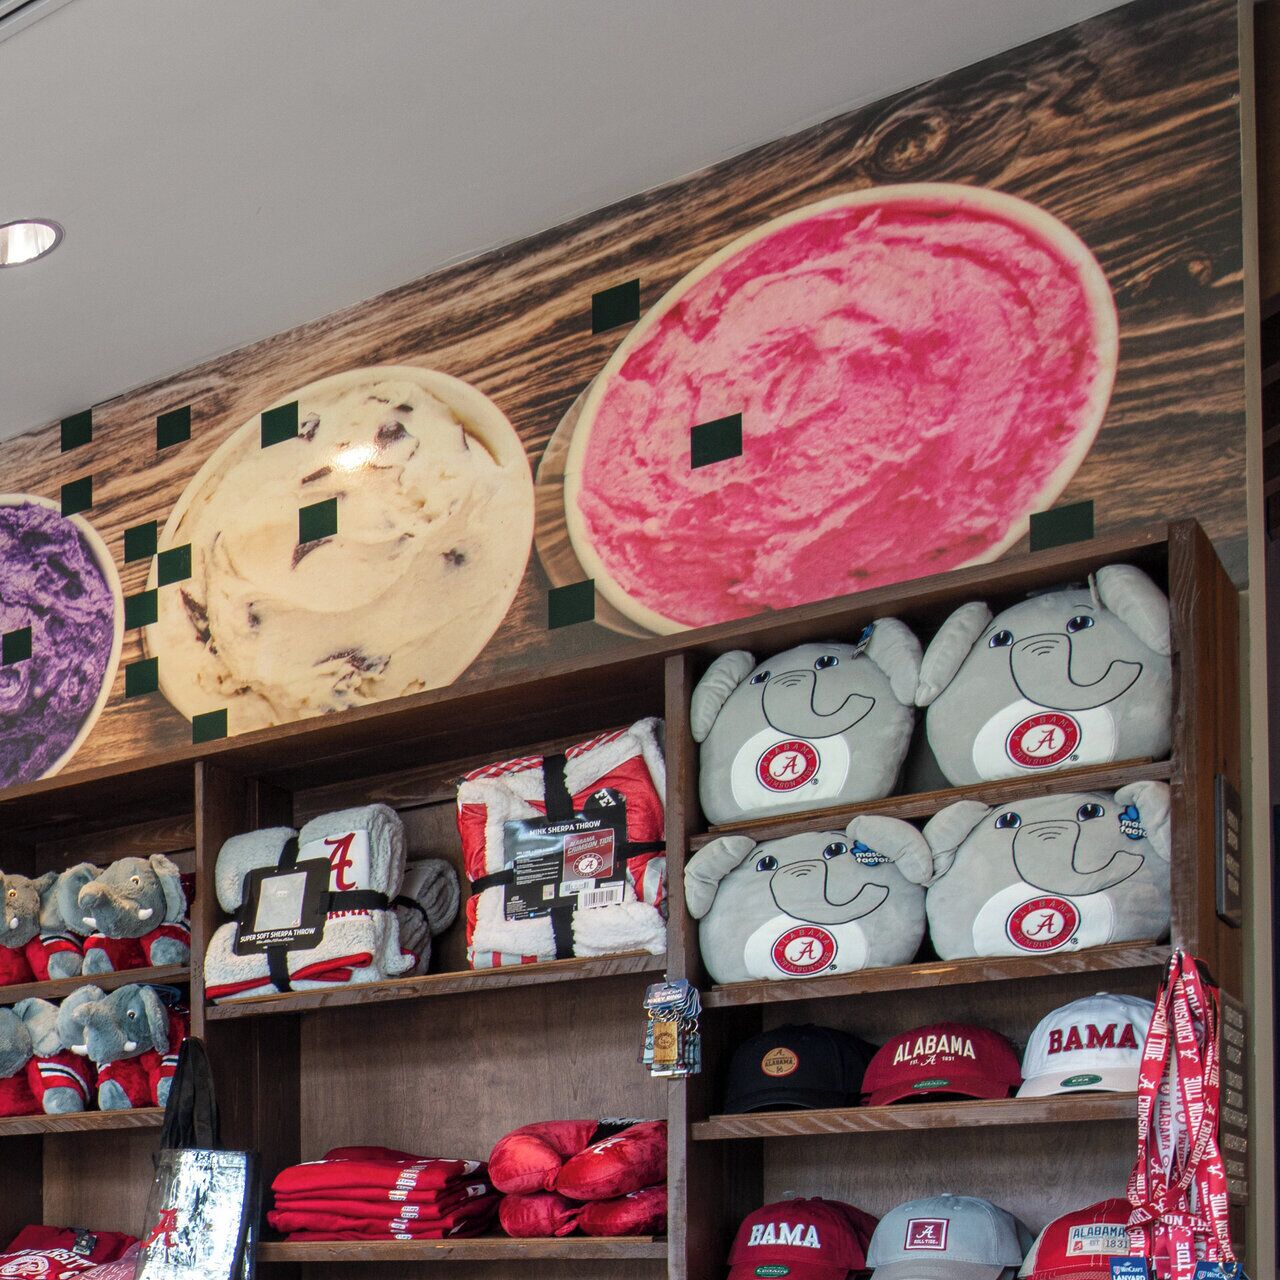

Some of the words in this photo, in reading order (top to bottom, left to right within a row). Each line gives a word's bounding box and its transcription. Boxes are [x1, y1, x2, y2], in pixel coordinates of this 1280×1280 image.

[1013, 715, 1074, 741] ALABAMA
[762, 743, 814, 767] ALABAMA
[529, 827, 547, 836] MINK
[548, 824, 575, 834] SHERPA
[576, 820, 601, 830] THROW
[1015, 899, 1074, 925] ALABAMA
[240, 934, 257, 943] SUPER
[256, 931, 270, 940] SOFT
[270, 929, 294, 939] SHERPA
[293, 927, 316, 937] THROW
[777, 929, 831, 953] ALABAMA
[1174, 999, 1195, 1045] CRIMSON
[893, 1034, 976, 1067] ALABAMA
[1047, 1022, 1139, 1057] BAMA
[1138, 1095, 1151, 1140] CRIMSON
[1158, 1099, 1172, 1151] ALABAMA
[1191, 1119, 1213, 1166] CRIMSON
[1177, 1167, 1197, 1190] TIDE
[1209, 1192, 1228, 1218] TIDE
[748, 1222, 822, 1249] BAMA
[1073, 1226, 1127, 1240] ALABAMA
[1105, 1239, 1129, 1249] 1831
